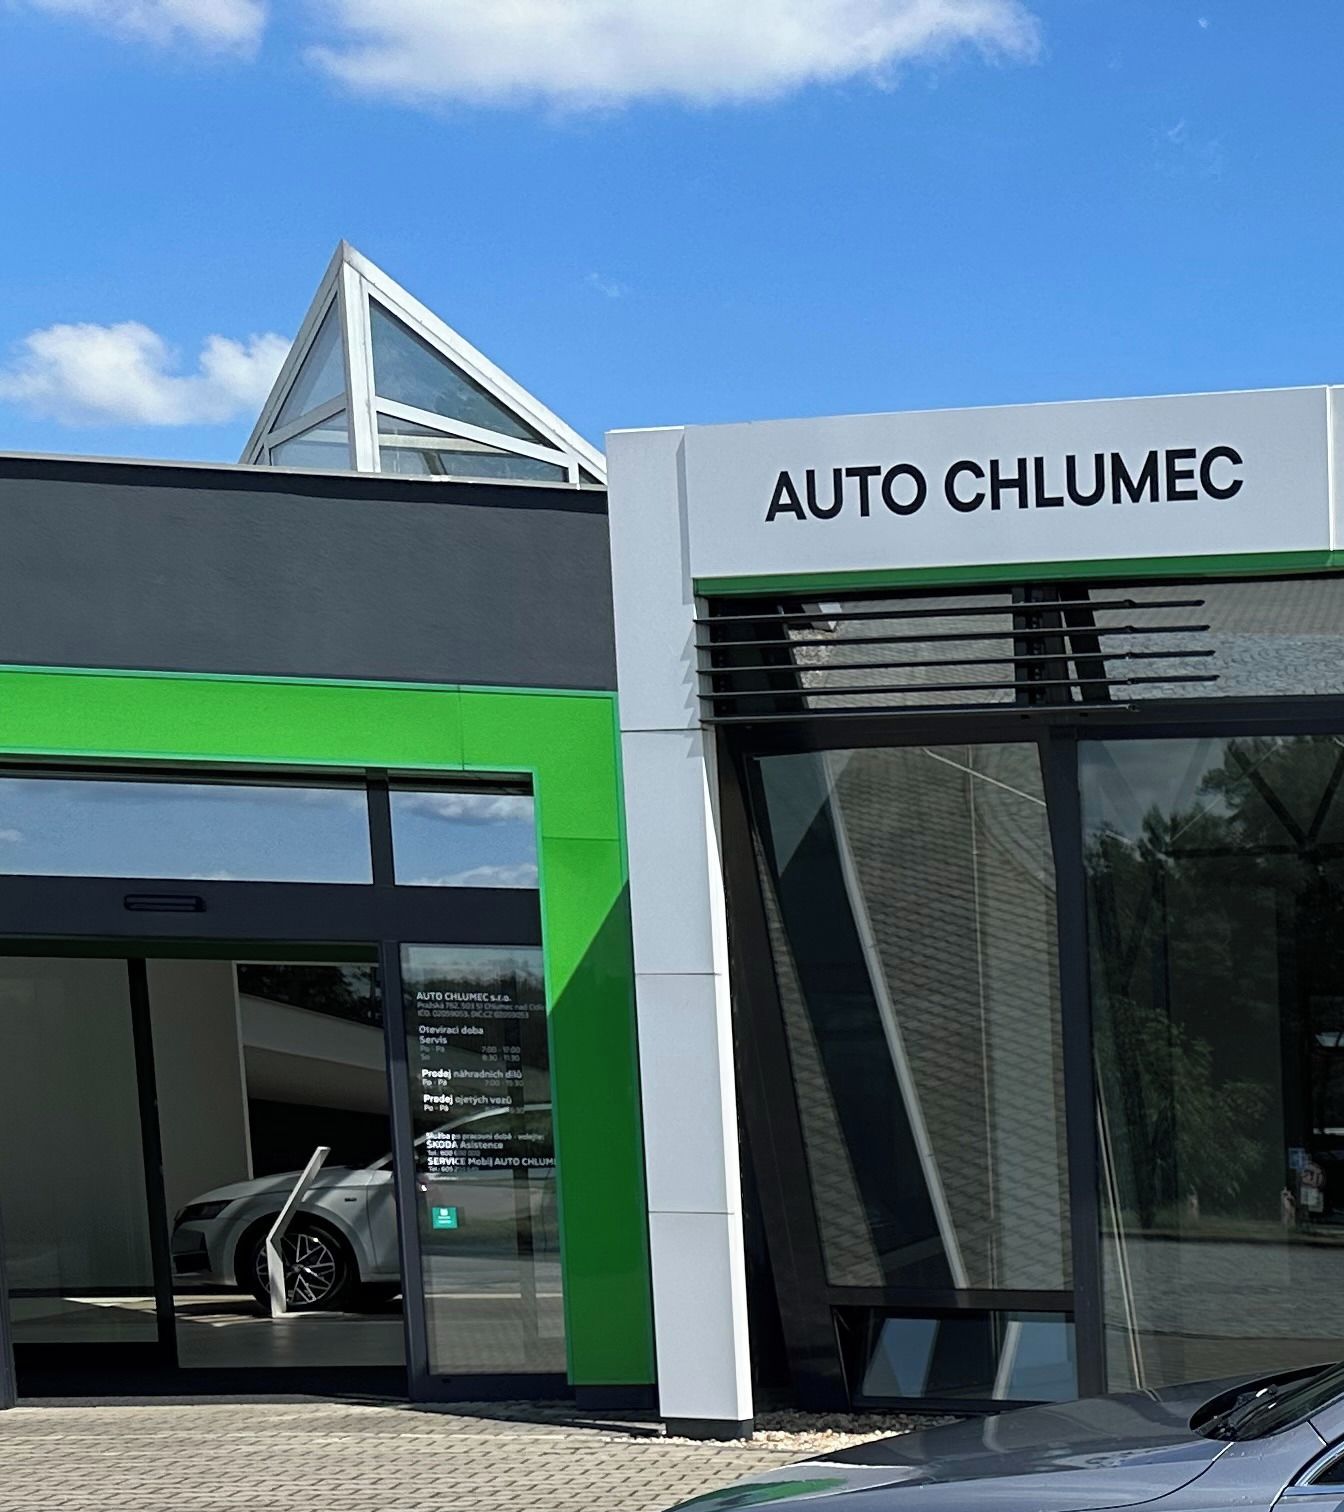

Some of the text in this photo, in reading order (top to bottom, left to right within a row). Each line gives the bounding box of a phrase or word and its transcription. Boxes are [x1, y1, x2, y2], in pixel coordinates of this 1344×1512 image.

[764, 445, 1244, 523] AUTO CHLUMEC
[417, 992, 443, 1001] AUTO
[444, 992, 489, 1002] CHLUMEC
[461, 1025, 484, 1035] doba
[419, 1035, 448, 1044] Servis
[421, 1069, 452, 1079] Prodej
[423, 1094, 453, 1105] Prodej
[426, 1140, 458, 1149] ŠKODA
[427, 1157, 466, 1166] SERVICE
[494, 1158, 519, 1166] AUTO
